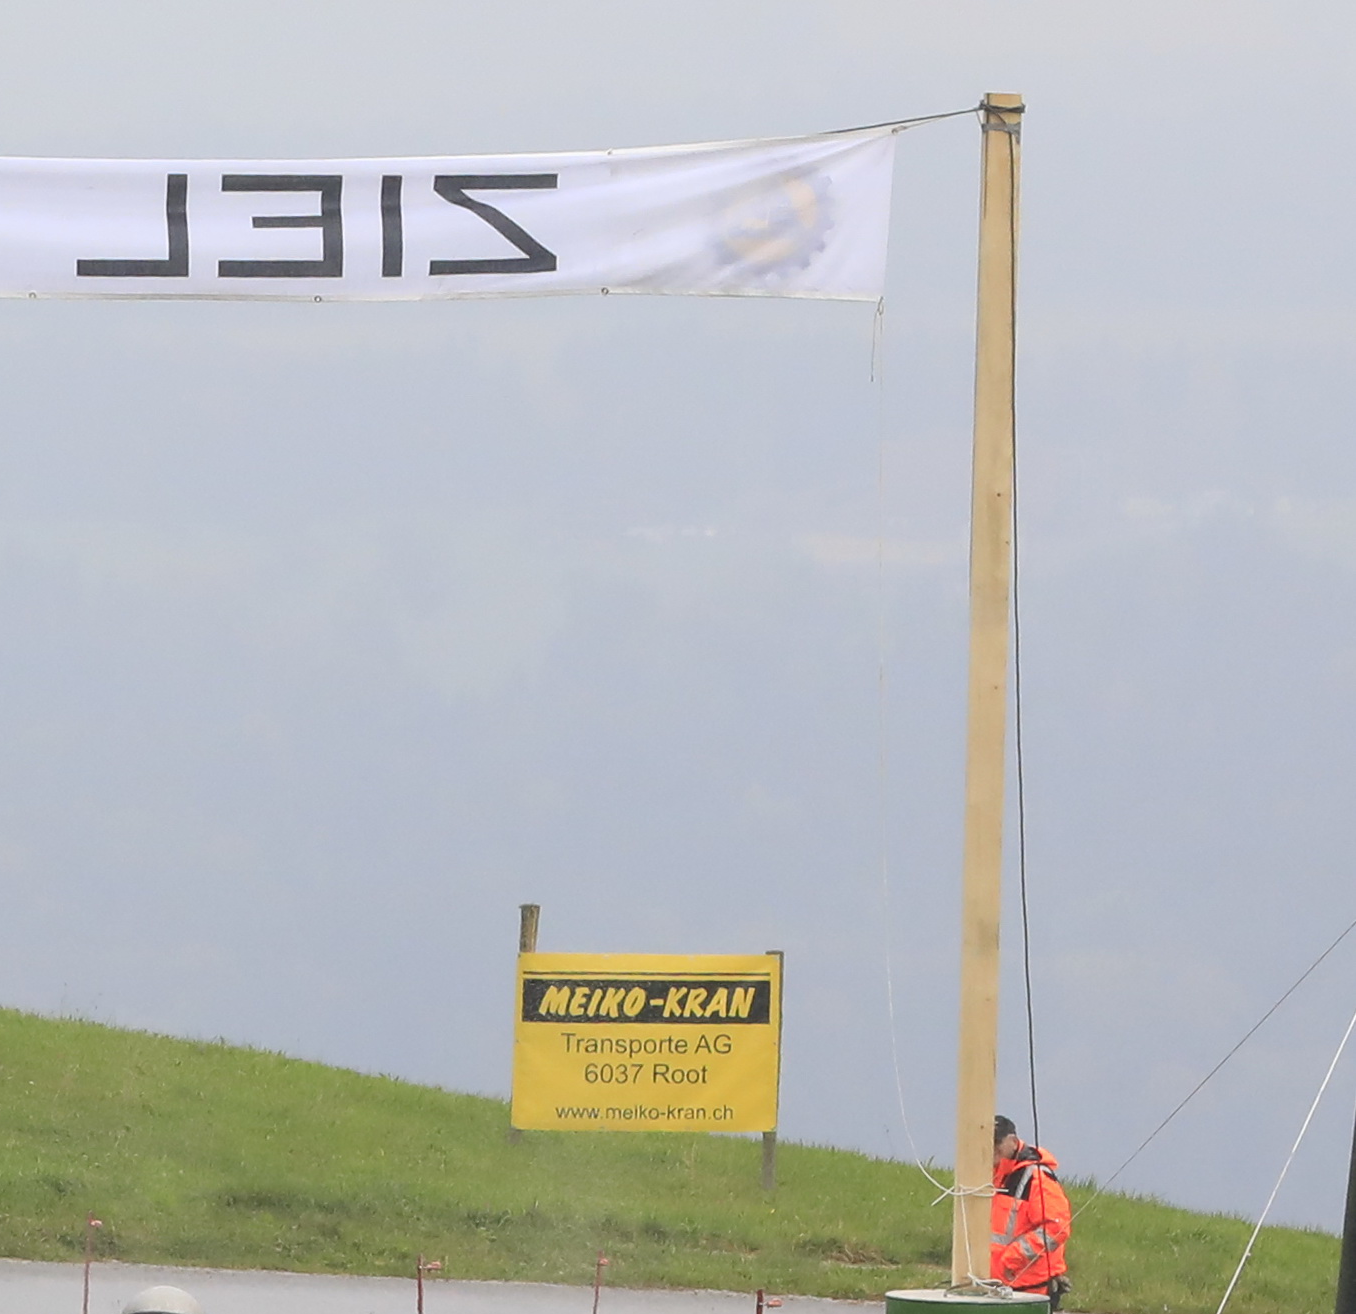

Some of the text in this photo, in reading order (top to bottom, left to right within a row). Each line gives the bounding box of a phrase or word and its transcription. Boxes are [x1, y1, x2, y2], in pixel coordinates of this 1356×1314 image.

[539, 985, 756, 1018] MEIKO-KRAN
[561, 1032, 732, 1058] Transporte AG
[584, 1063, 708, 1084] 6037 Root
[555, 1105, 734, 1120] www.meiko-kran.ch
